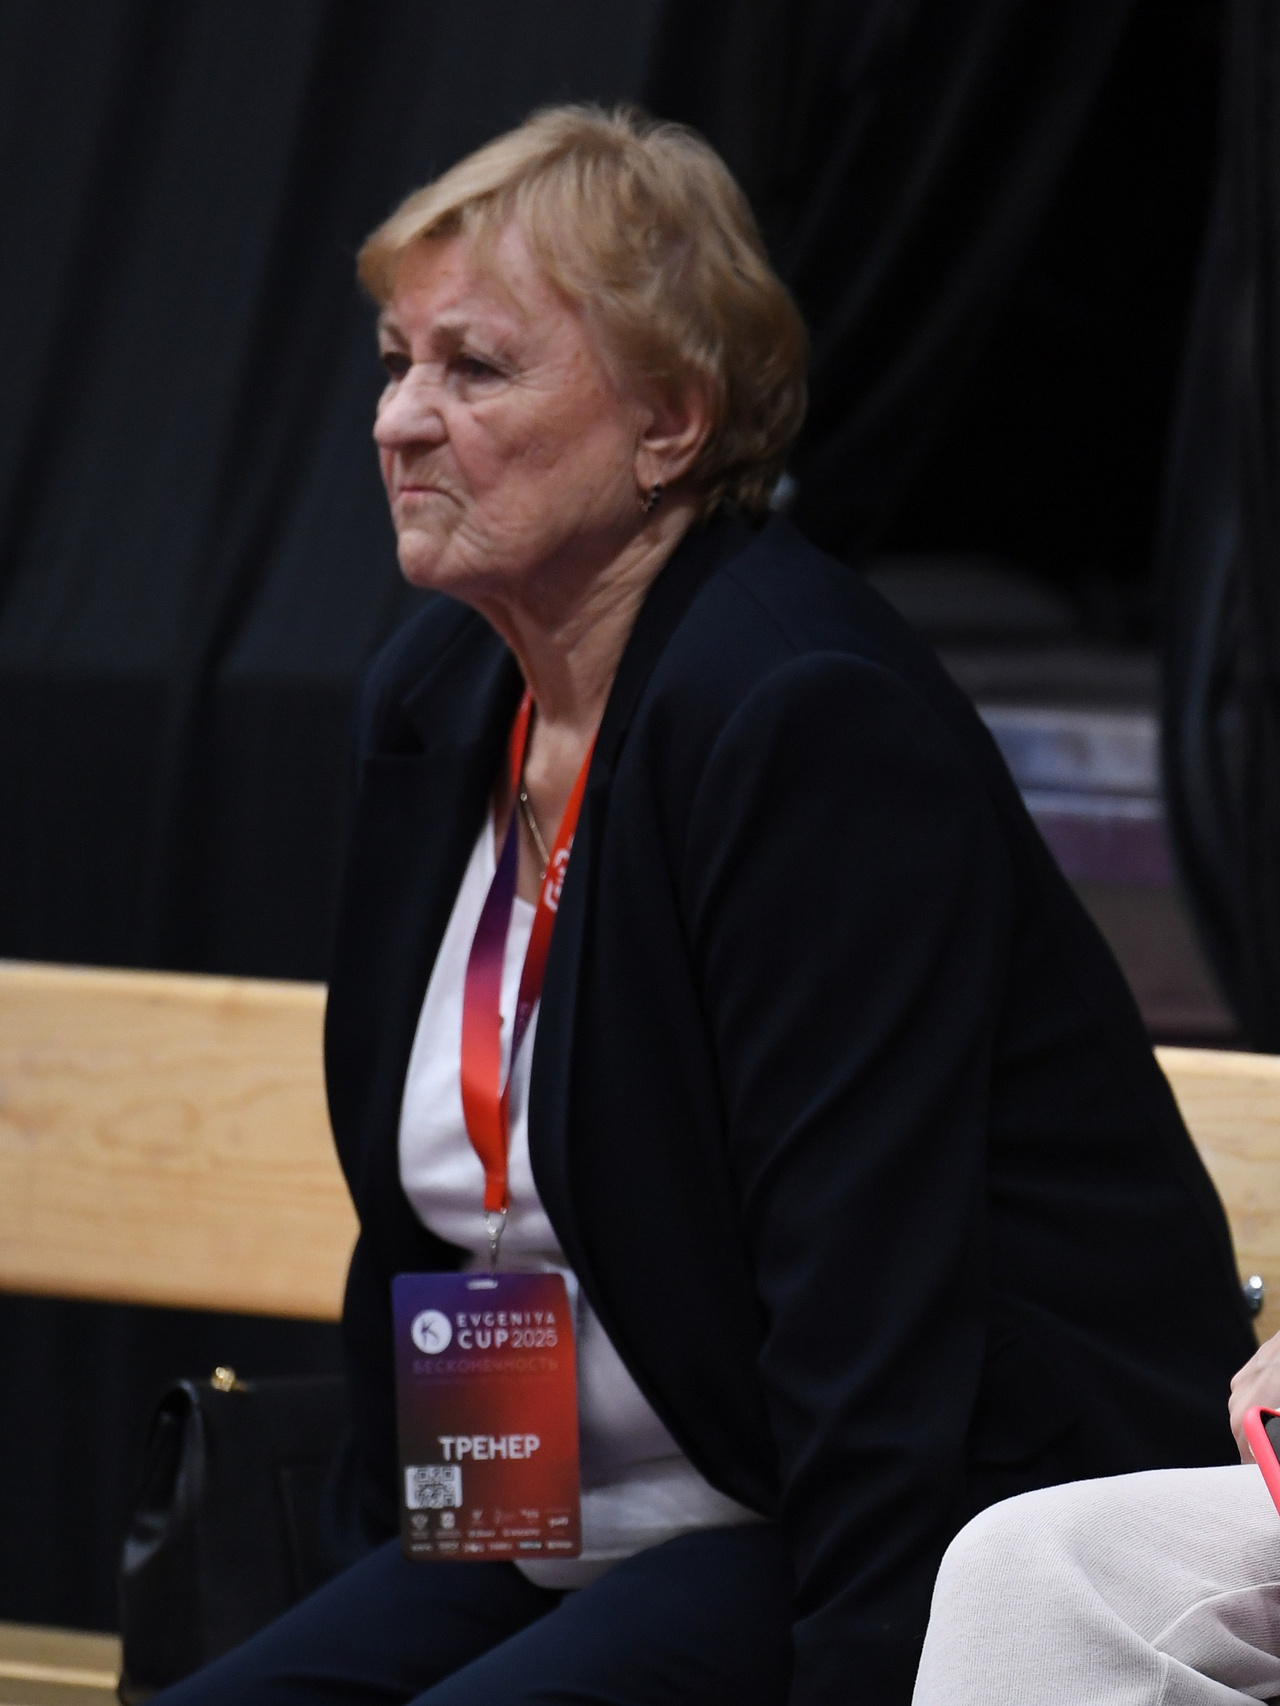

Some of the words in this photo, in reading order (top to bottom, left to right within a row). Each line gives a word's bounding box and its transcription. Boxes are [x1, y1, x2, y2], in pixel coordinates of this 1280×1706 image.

[456, 1312, 556, 1327] EVGENIYA
[457, 1330, 508, 1349] CUP
[511, 1329, 558, 1348] 2025
[438, 1434, 540, 1461] ТРЕНЕР
